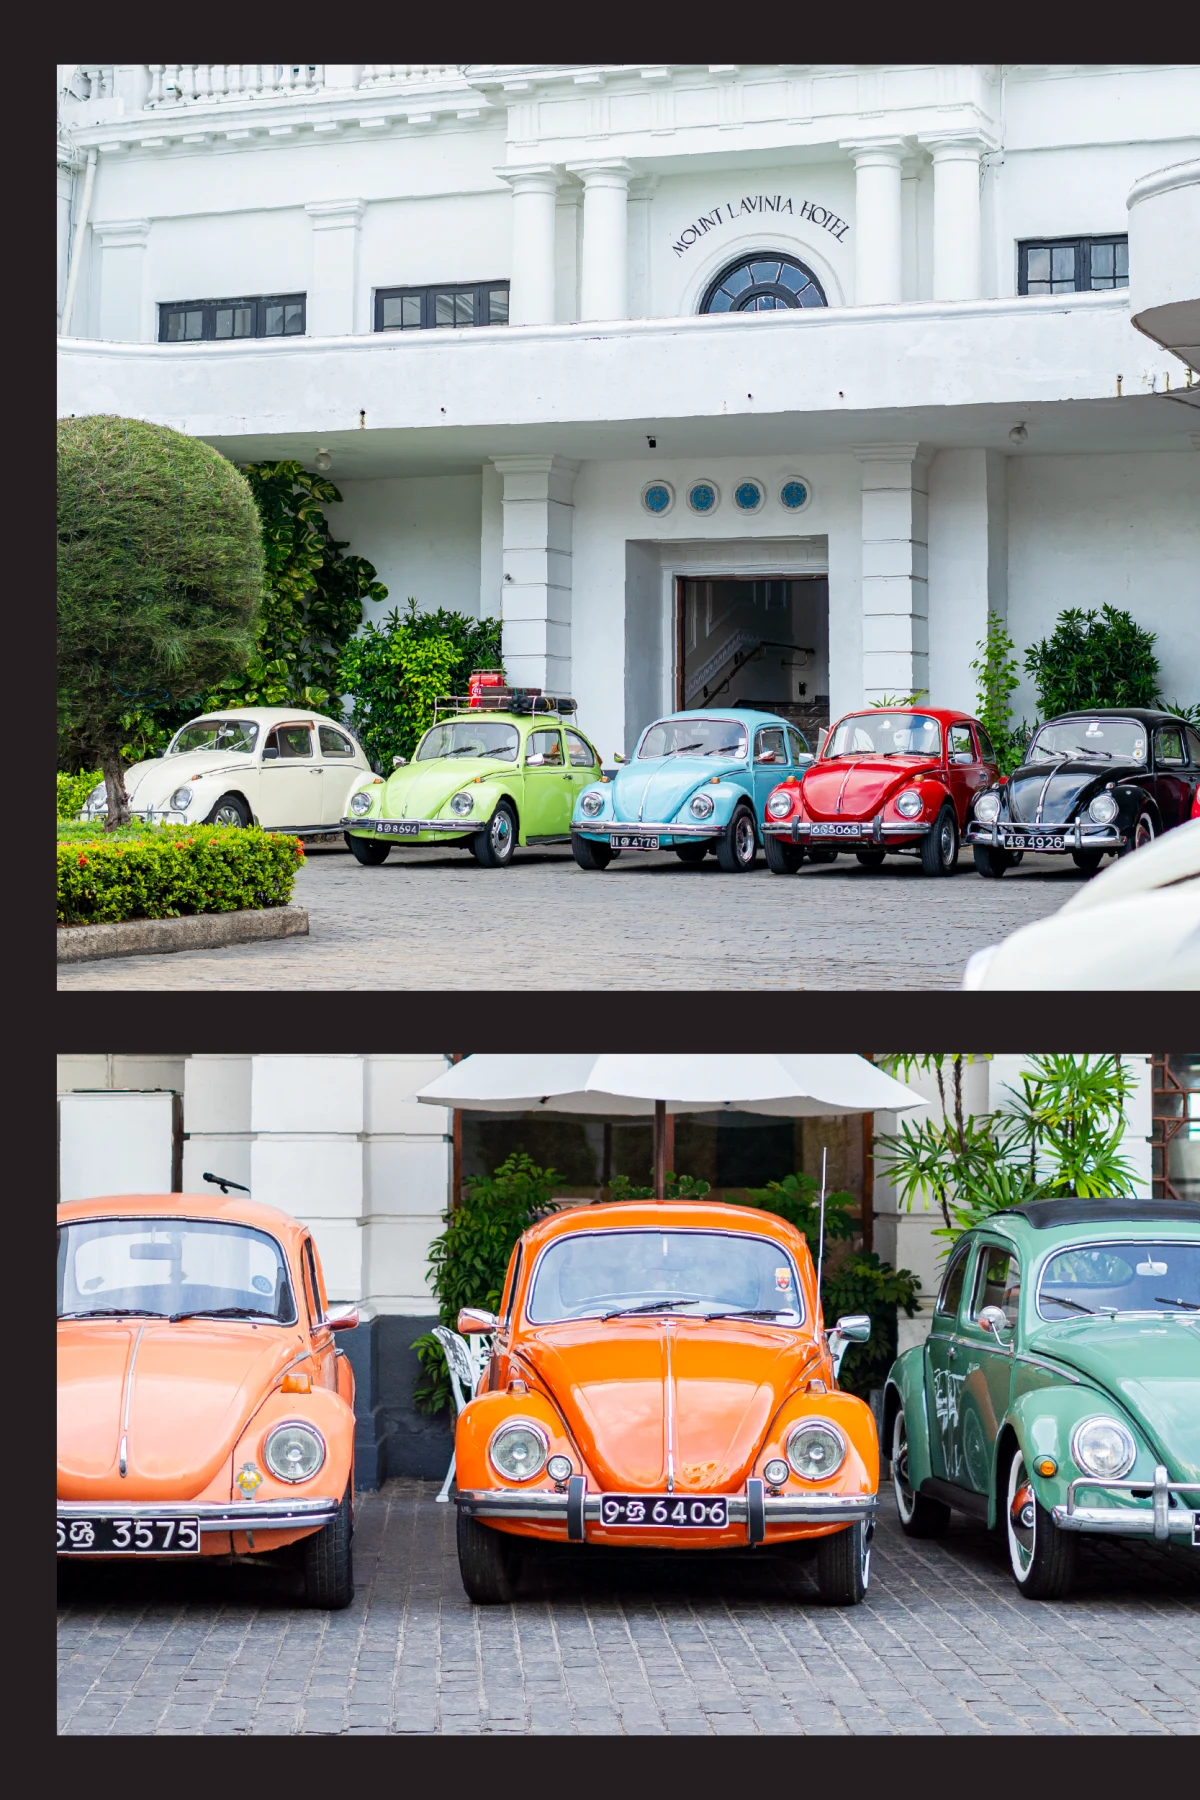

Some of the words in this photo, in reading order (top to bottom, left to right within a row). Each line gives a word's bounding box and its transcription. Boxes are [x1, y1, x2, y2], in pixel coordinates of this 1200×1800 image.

[671, 207, 724, 258] MOUNT
[726, 195, 794, 220] LAVINIA
[799, 200, 851, 244] HOTEL
[1027, 836, 1063, 849] 4926
[604, 1501, 620, 1523] 9
[651, 1500, 725, 1524] 6406
[112, 1520, 198, 1549] 3575
